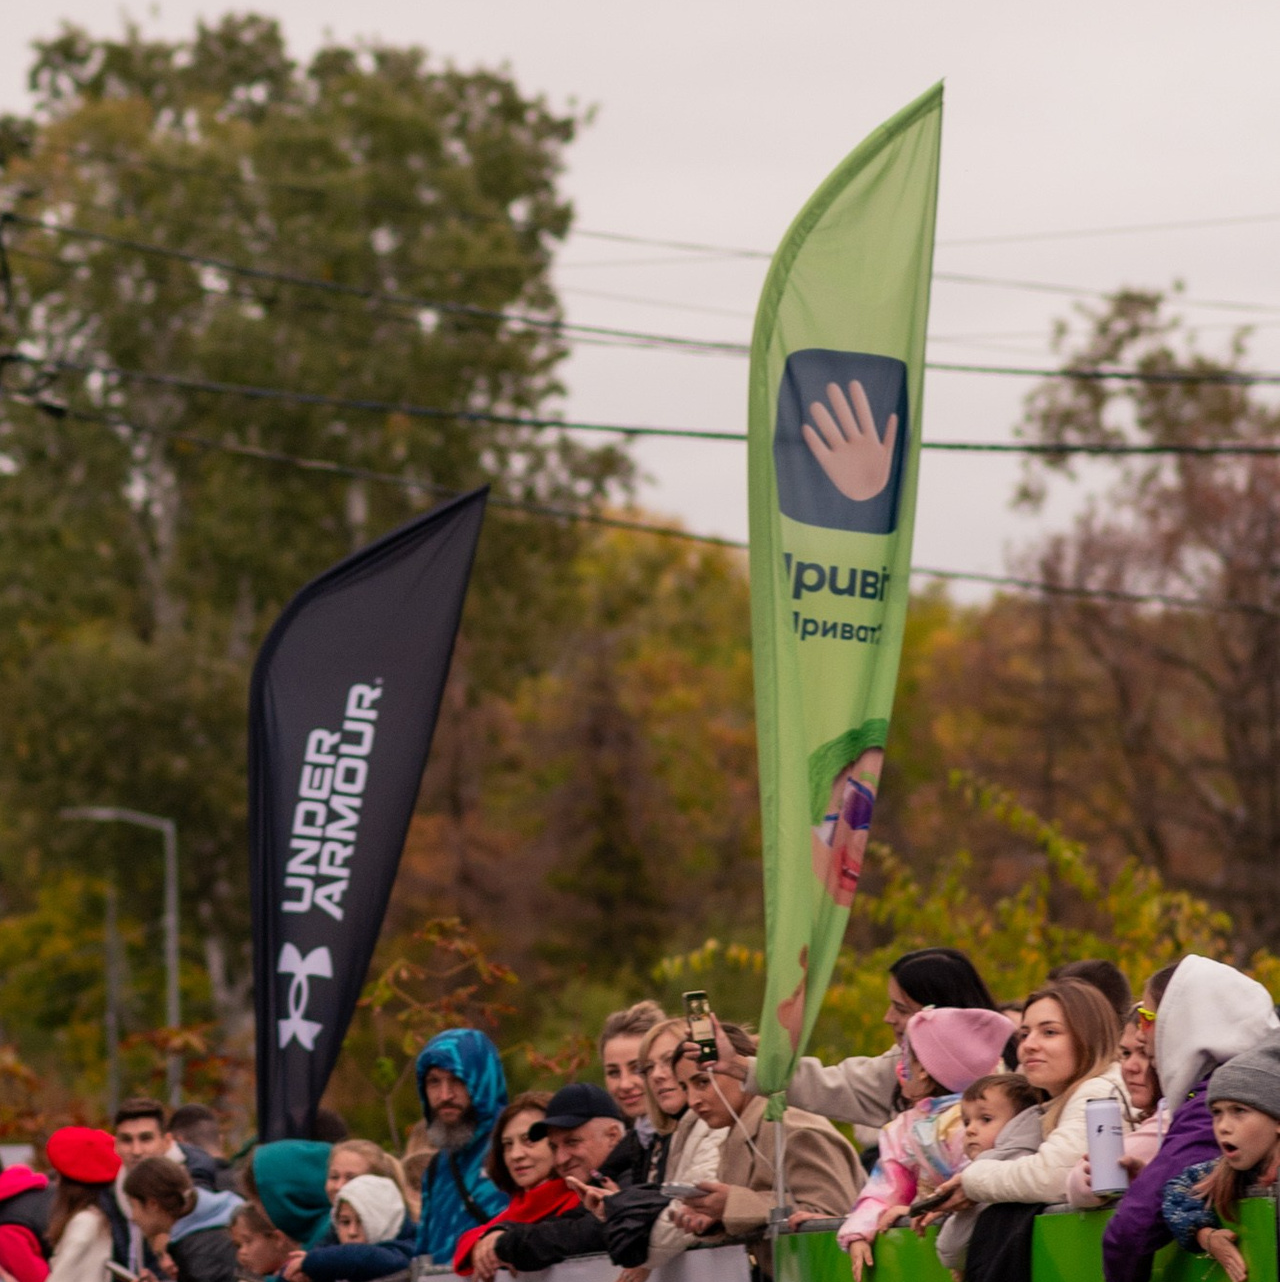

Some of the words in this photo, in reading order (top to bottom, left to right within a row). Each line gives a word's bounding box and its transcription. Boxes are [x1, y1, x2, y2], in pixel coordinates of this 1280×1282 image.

[783, 552, 890, 601] риві
[281, 728, 341, 913] UNDER
[313, 683, 381, 920] ARMOUR
